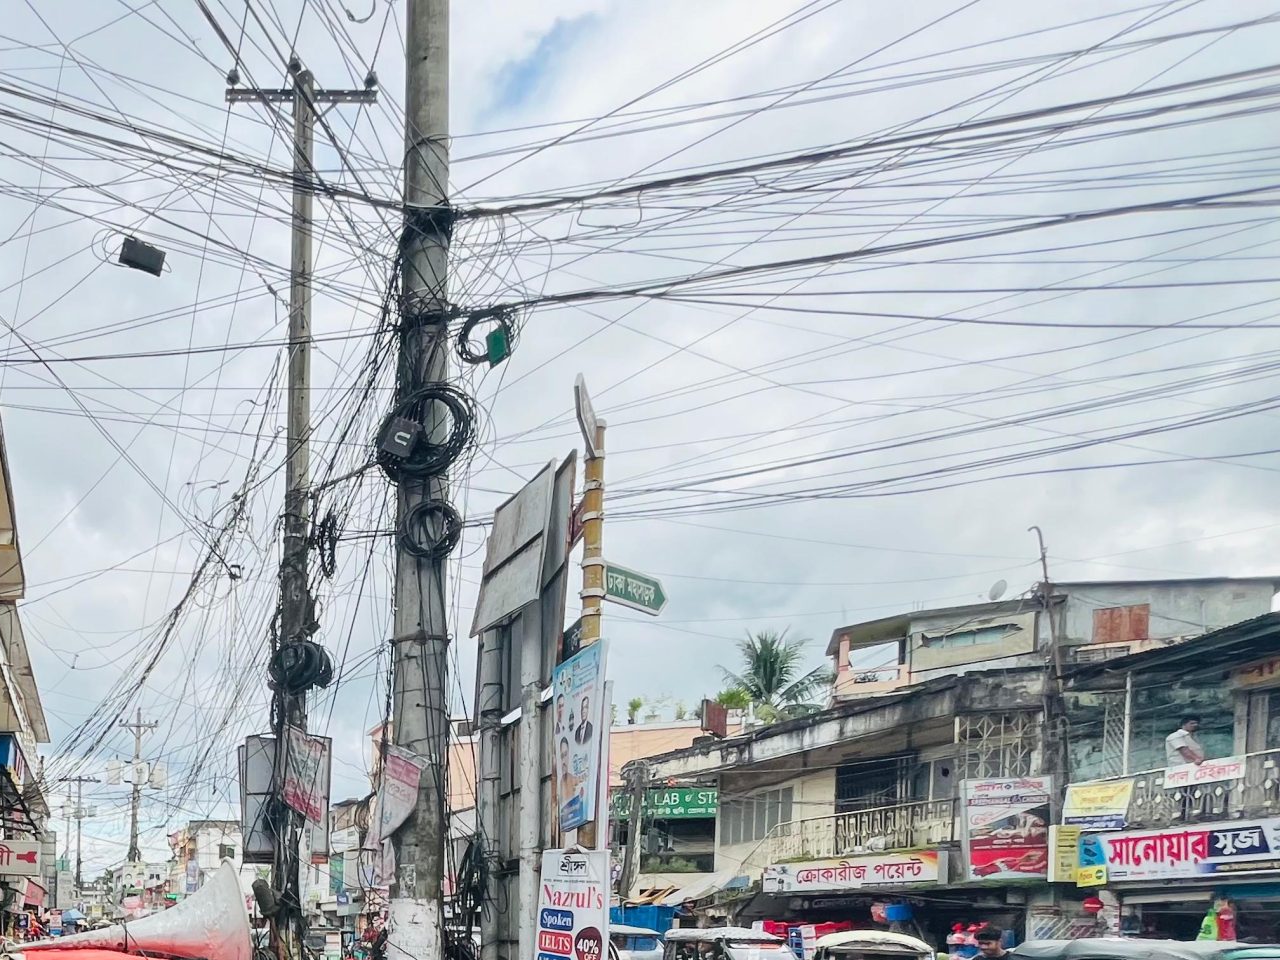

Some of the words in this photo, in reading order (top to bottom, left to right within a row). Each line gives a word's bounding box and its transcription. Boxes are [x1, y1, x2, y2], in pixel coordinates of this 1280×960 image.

[654, 792, 680, 806] LAB
[1213, 828, 1262, 855] সুজ
[796, 860, 868, 885] ক্রোকারীজ
[873, 858, 924, 881] পয়েন্ট
[543, 884, 603, 910] Nazrul's
[542, 911, 572, 928] Spoken
[540, 934, 571, 951] IELTS
[576, 938, 599, 955] 40%
